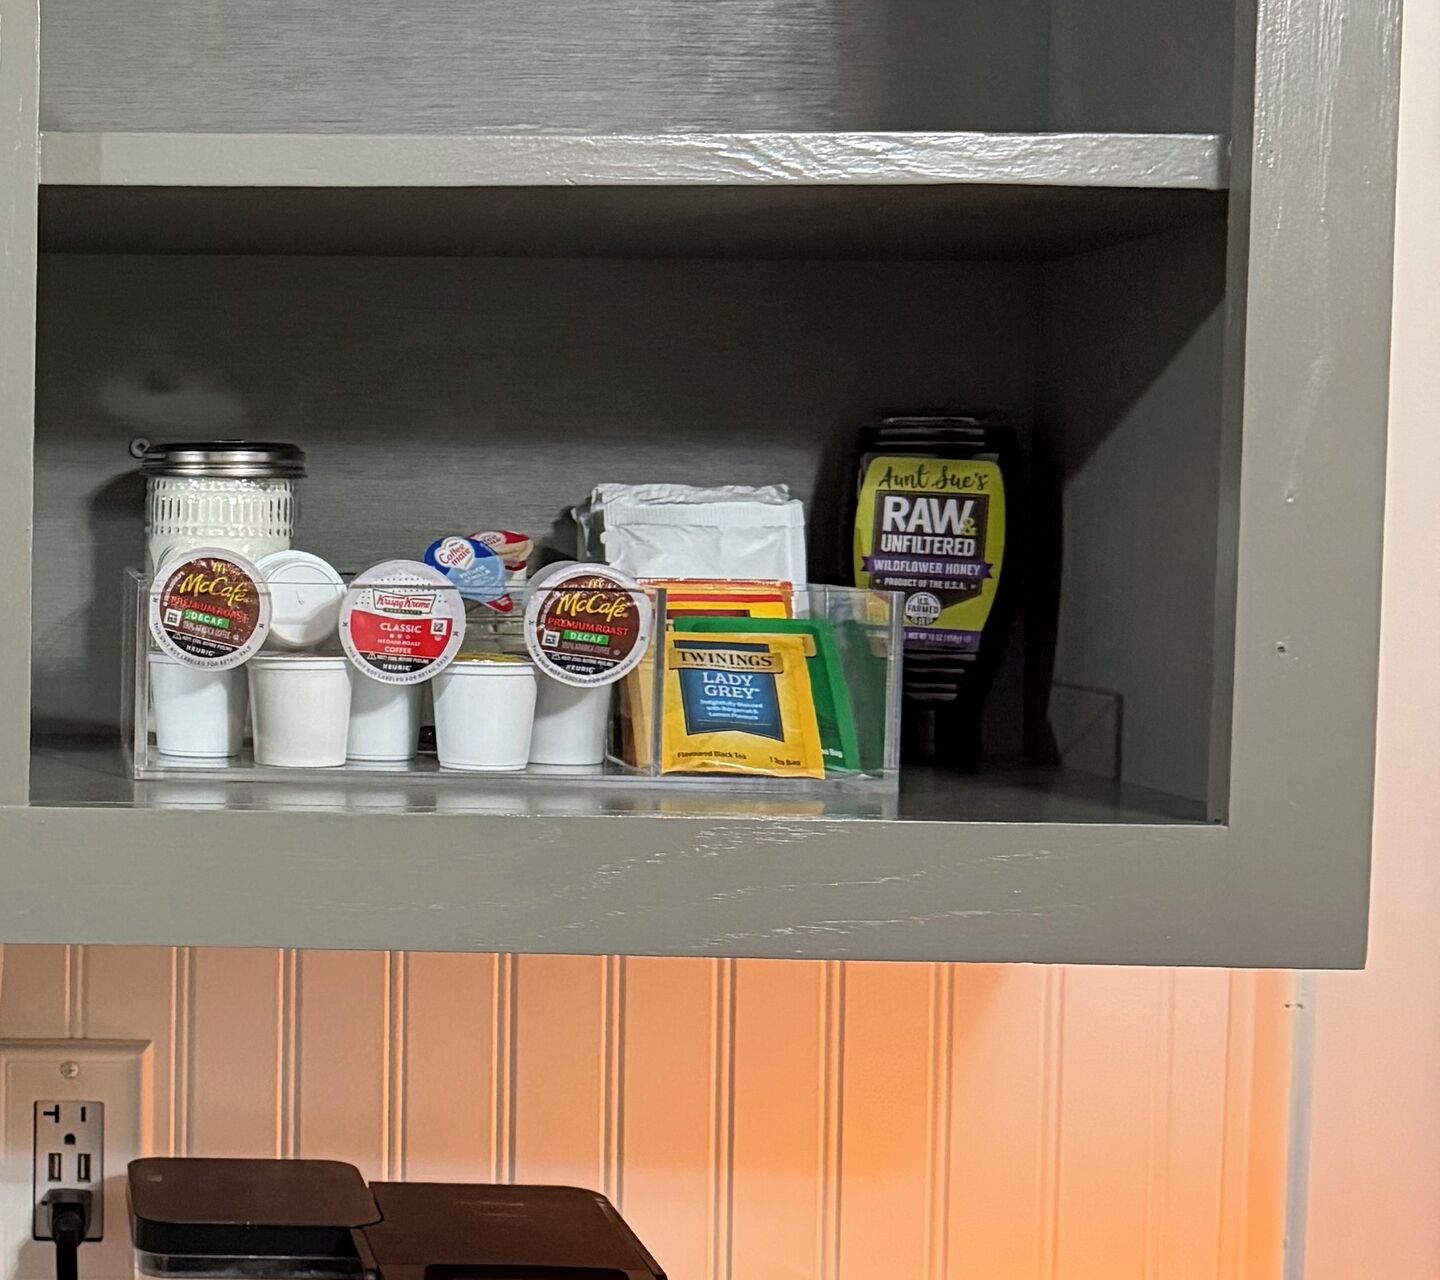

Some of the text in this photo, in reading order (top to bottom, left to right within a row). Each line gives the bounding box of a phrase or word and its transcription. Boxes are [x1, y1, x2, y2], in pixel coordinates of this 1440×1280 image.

[878, 464, 989, 491] Aunt Sue's
[883, 496, 977, 536] RAW &
[881, 533, 976, 557] UNFILTERED
[439, 543, 466, 565] Coffee
[451, 548, 471, 566] mate
[873, 559, 981, 576] WILDFLOWER HONEY
[884, 577, 917, 587] PRODUCT
[918, 580, 928, 588] OF
[929, 580, 943, 589] THE
[908, 604, 939, 614] FARMED
[190, 612, 224, 626] DECAF
[380, 622, 422, 634] CLASSIC
[570, 631, 603, 644] DECAF
[384, 646, 412, 655] COFFEE
[677, 650, 774, 667] TWININGS
[703, 672, 753, 686] LADY
[704, 685, 756, 700] GREY
[677, 750, 747, 760] Flavoured Black Tea
